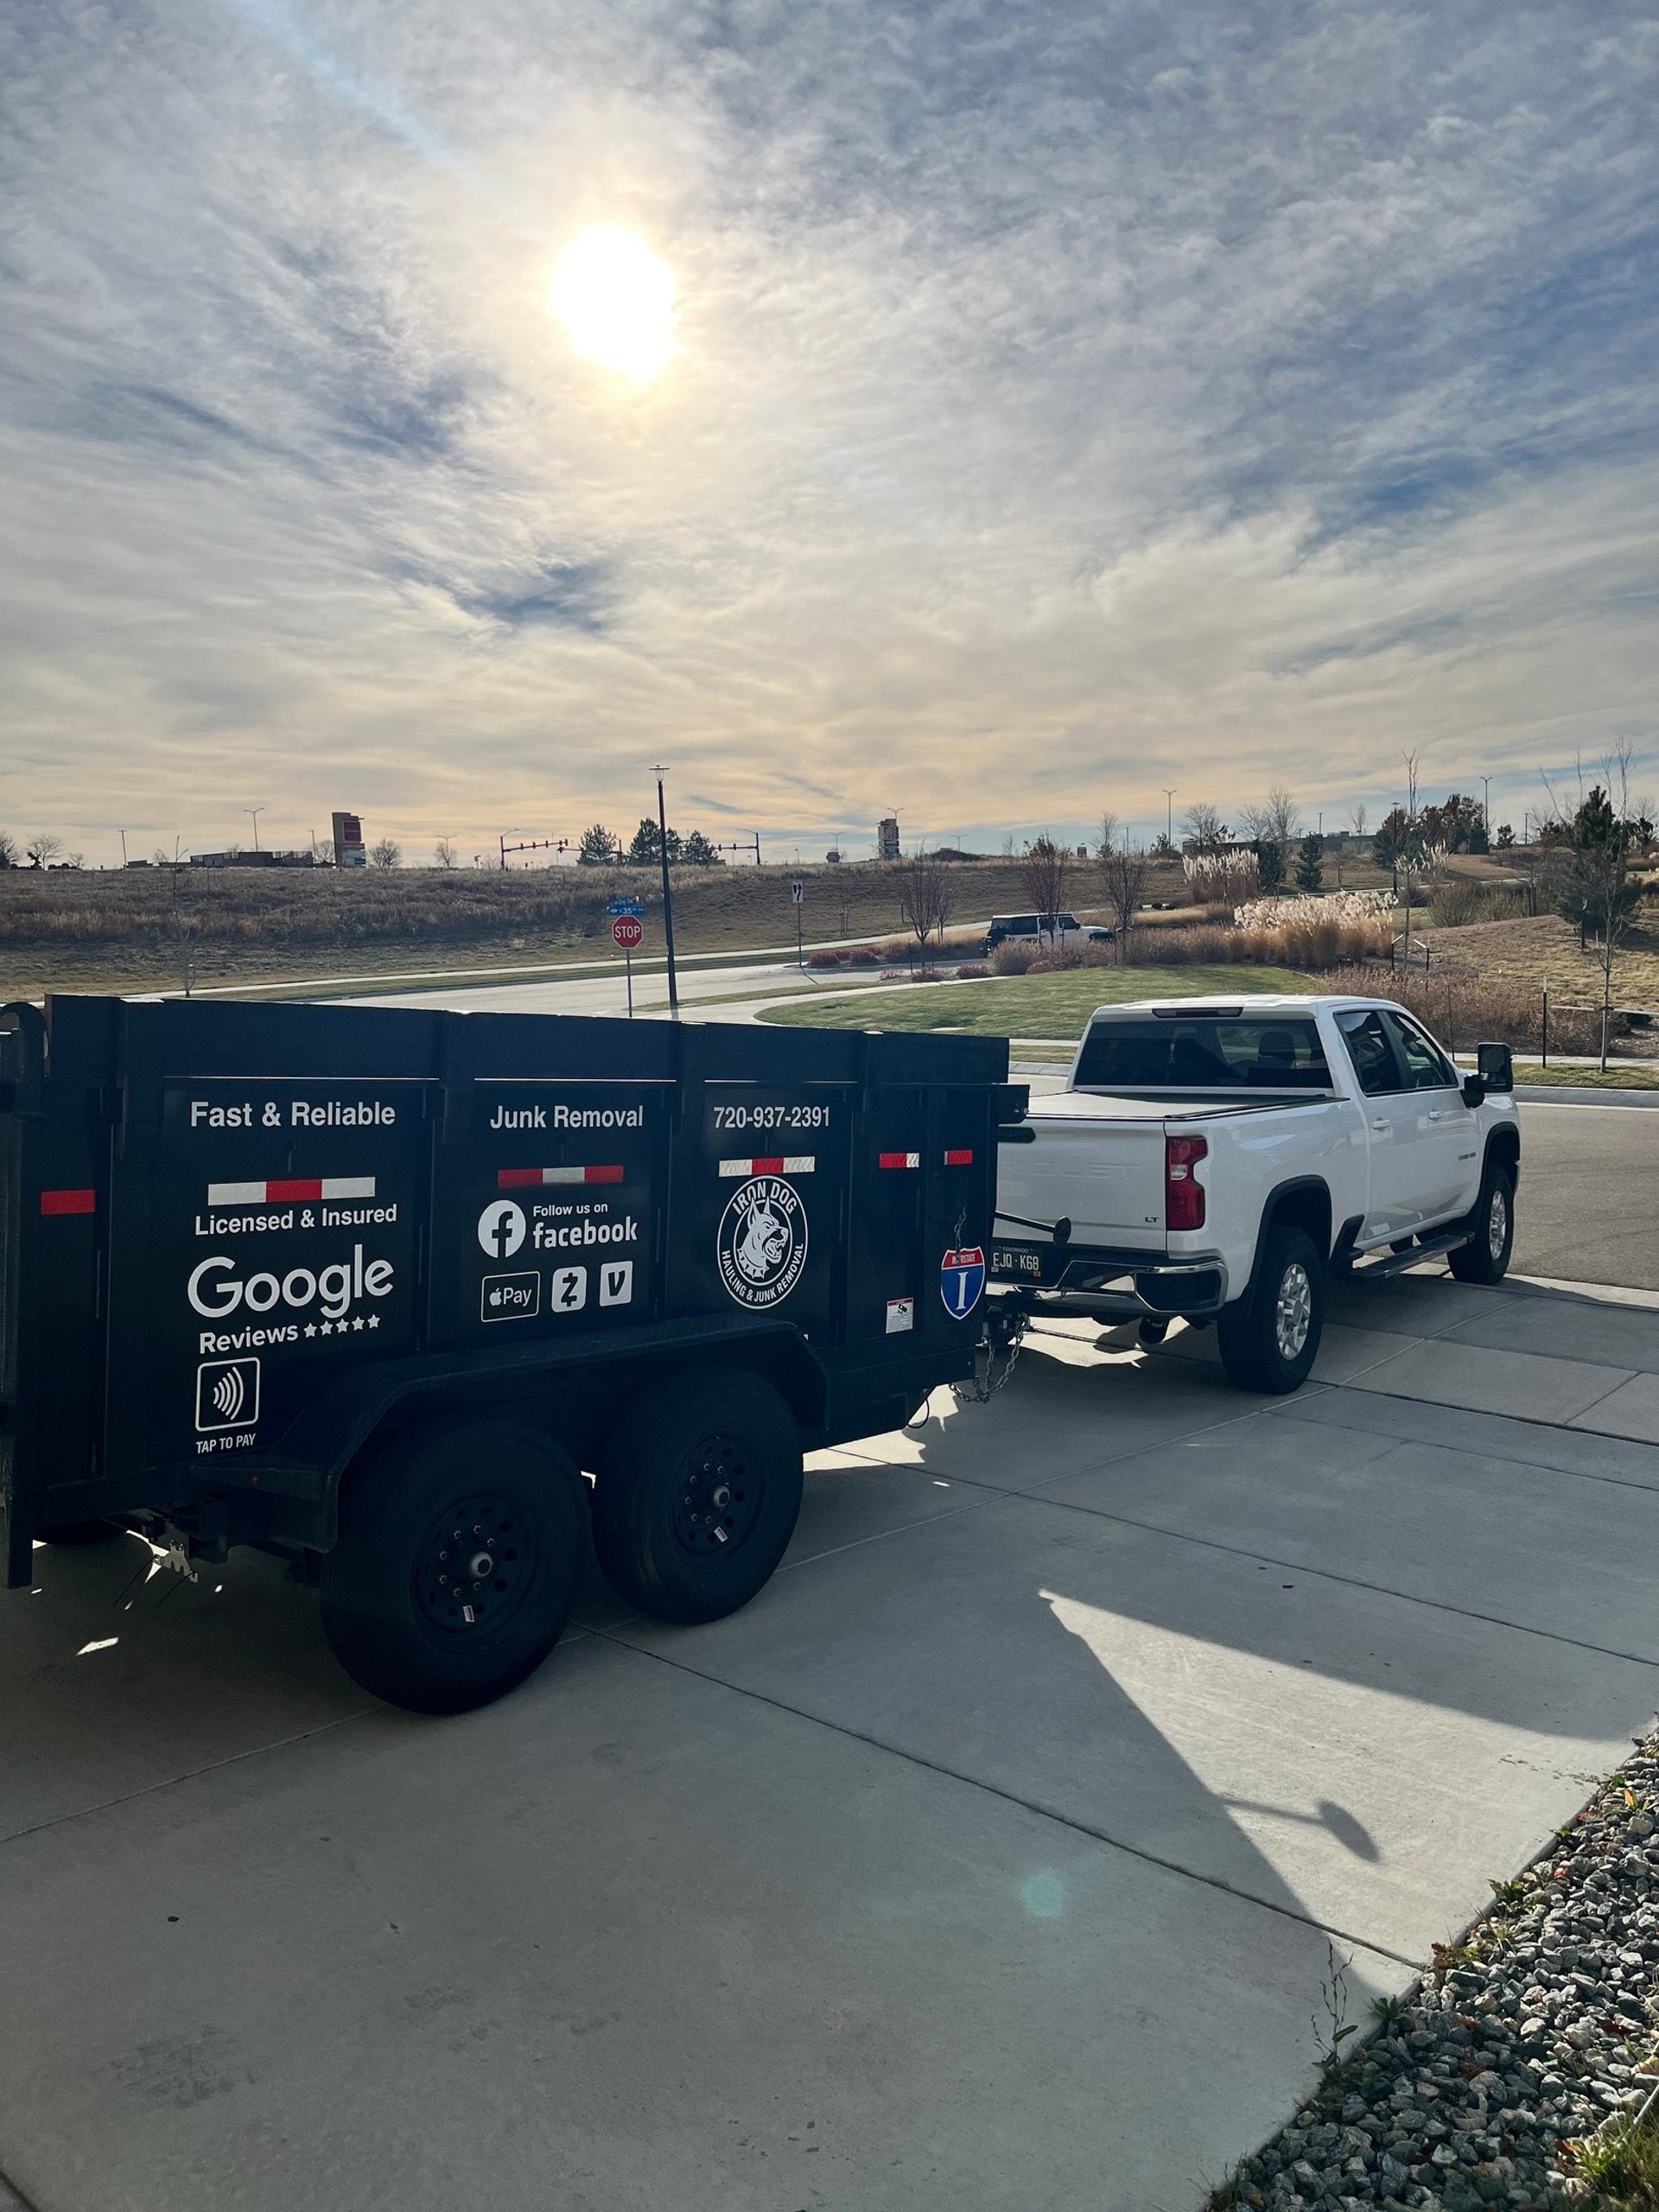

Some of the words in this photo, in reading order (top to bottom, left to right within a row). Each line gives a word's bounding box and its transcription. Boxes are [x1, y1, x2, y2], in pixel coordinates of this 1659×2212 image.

[614, 925, 640, 938] STOP
[192, 1102, 252, 1127] Fast
[262, 1102, 281, 1126] &
[292, 1102, 395, 1126] Reliable
[491, 1106, 546, 1128] Junk
[555, 1106, 643, 1128] Removal
[714, 1107, 829, 1128] 720-937-2391
[533, 1205, 573, 1217] Follow
[576, 1205, 590, 1214] us
[594, 1204, 607, 1212] on
[732, 1181, 766, 1215] IRON
[770, 1181, 798, 1215] DOG
[195, 1211, 293, 1235] Licensed
[301, 1210, 315, 1228] &
[322, 1204, 397, 1226] Insured
[533, 1216, 638, 1249] facebook
[188, 1244, 393, 1319] Google
[721, 1249, 746, 1297] HAULING
[746, 1288, 753, 1302] &
[753, 1288, 777, 1303] JUNK
[776, 1243, 804, 1294] REMOVAL
[503, 1287, 532, 1307] Pay
[200, 1325, 298, 1354] Reviews
[196, 1440, 216, 1453] TAP
[219, 1437, 232, 1449] TO
[237, 1433, 256, 1447] PAY
